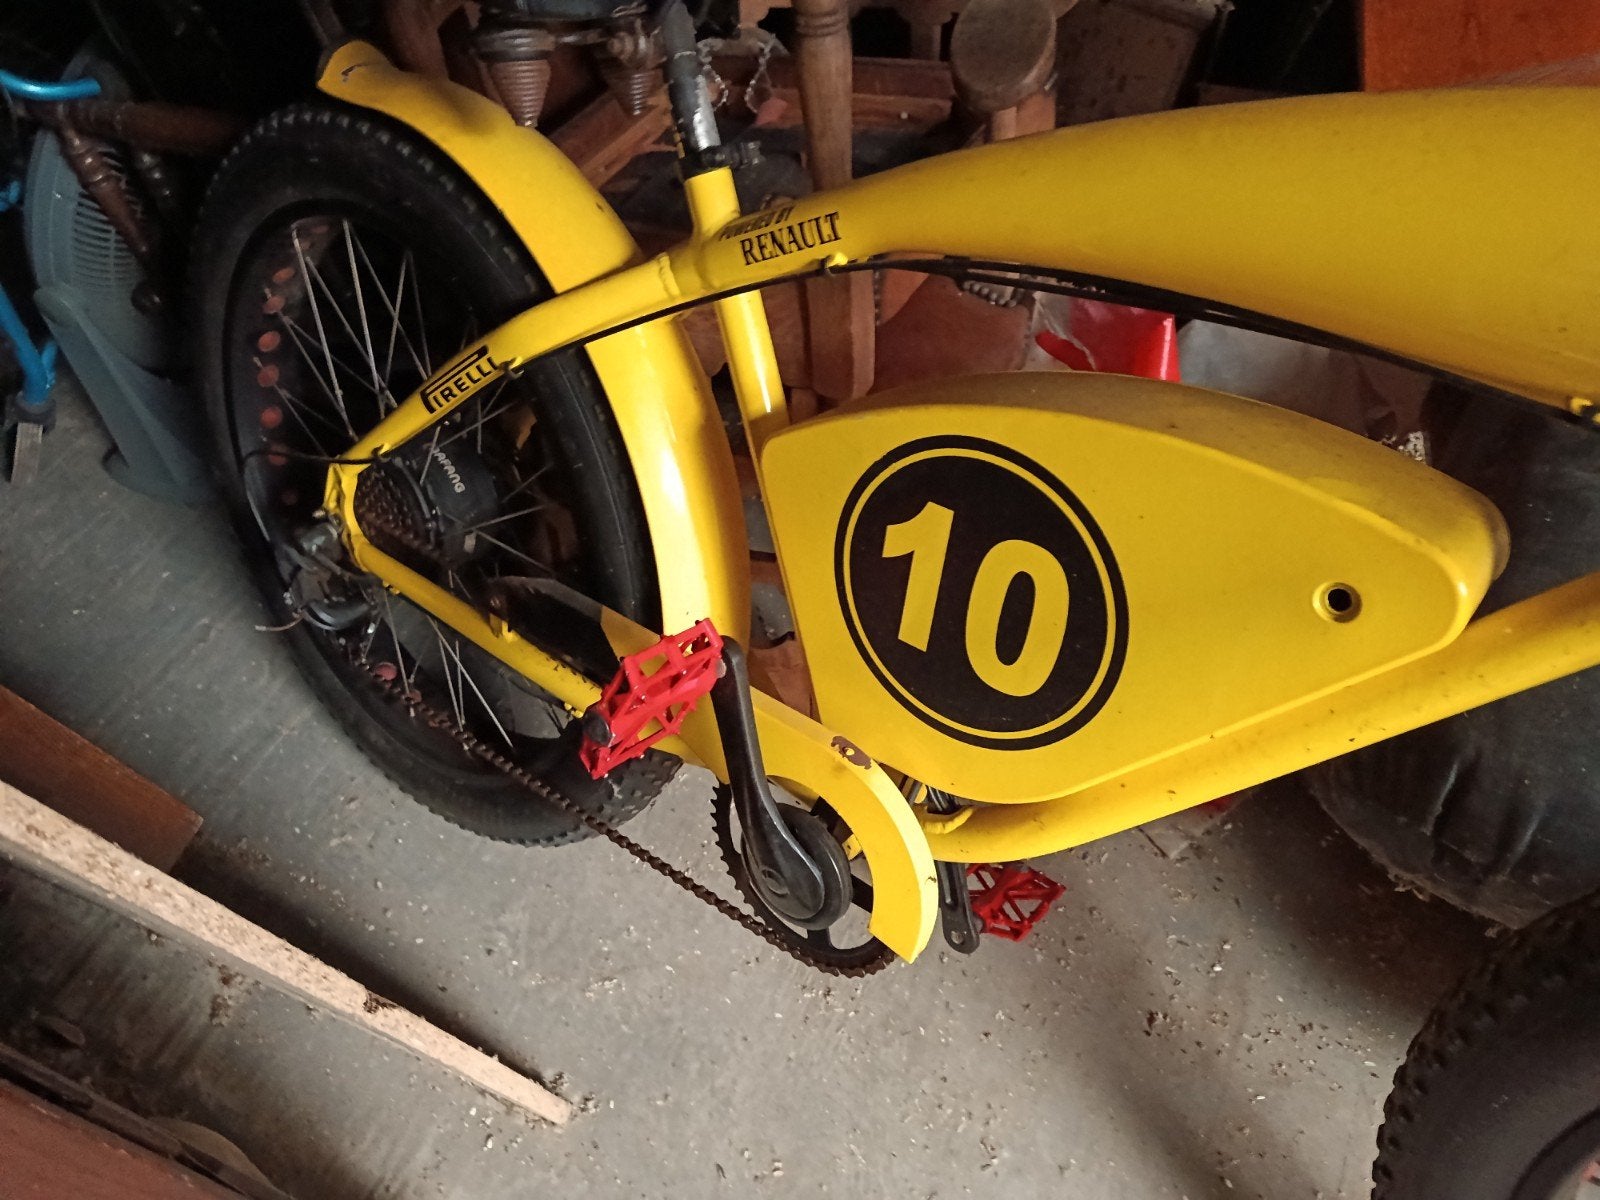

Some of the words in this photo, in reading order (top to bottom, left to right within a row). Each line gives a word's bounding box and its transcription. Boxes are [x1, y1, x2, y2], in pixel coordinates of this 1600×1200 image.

[740, 212, 842, 265] RENAULT
[420, 344, 500, 414] PIRELLI
[882, 501, 1070, 697] 10
